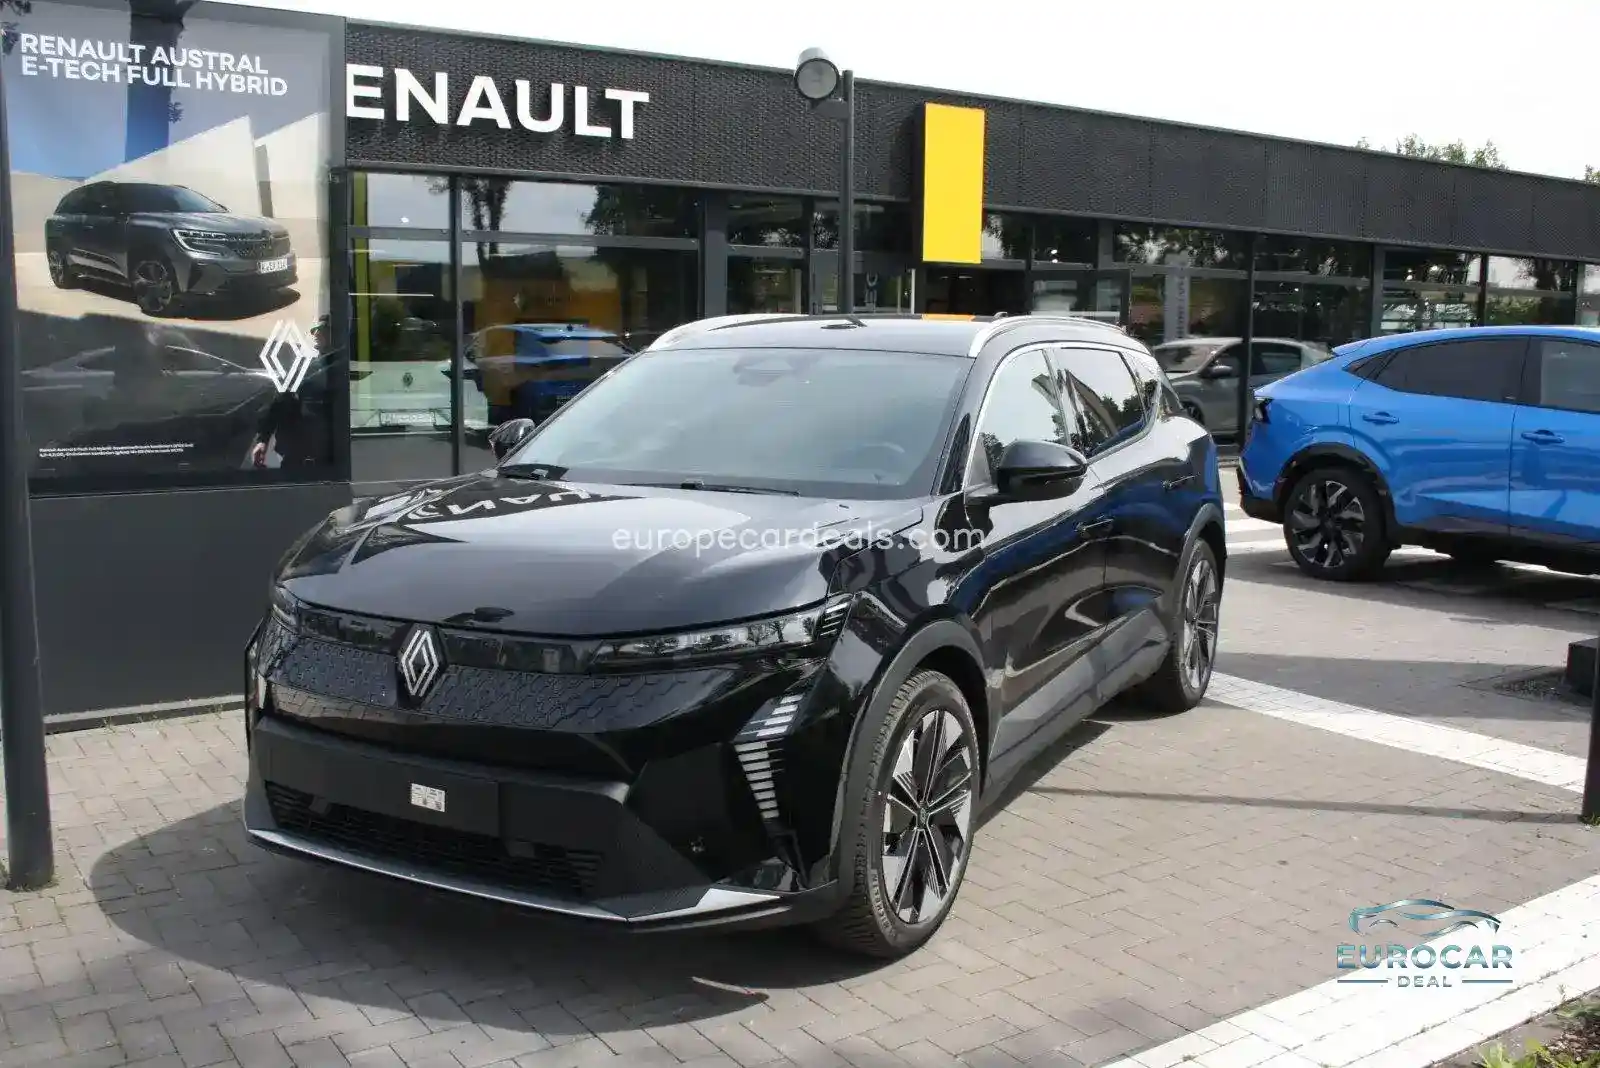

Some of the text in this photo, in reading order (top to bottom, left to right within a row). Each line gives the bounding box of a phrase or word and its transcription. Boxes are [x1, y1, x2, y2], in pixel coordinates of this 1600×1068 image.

[21, 33, 269, 75] RENAULT AUSTRAL
[22, 55, 288, 97] E-TECH FULL HYBRID
[346, 63, 649, 139] ENAULT
